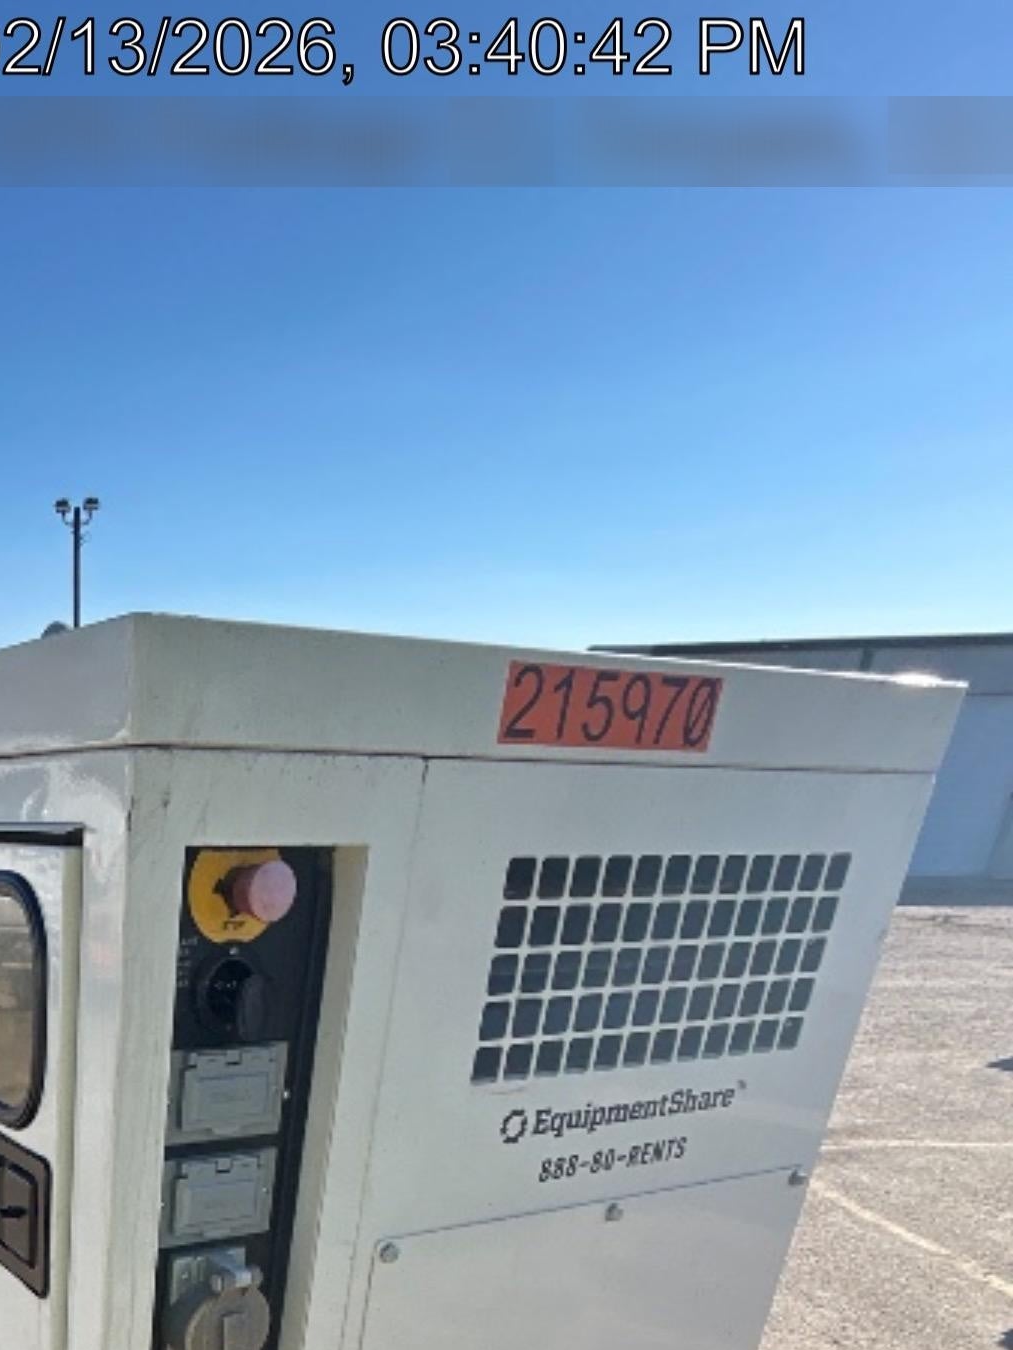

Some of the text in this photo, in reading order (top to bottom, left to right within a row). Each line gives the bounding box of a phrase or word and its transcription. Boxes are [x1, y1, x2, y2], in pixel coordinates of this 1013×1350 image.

[502, 663, 718, 746] 215970
[531, 1088, 735, 1138] EquipmentShare
[538, 1136, 687, 1183] 888-80-RENTS
